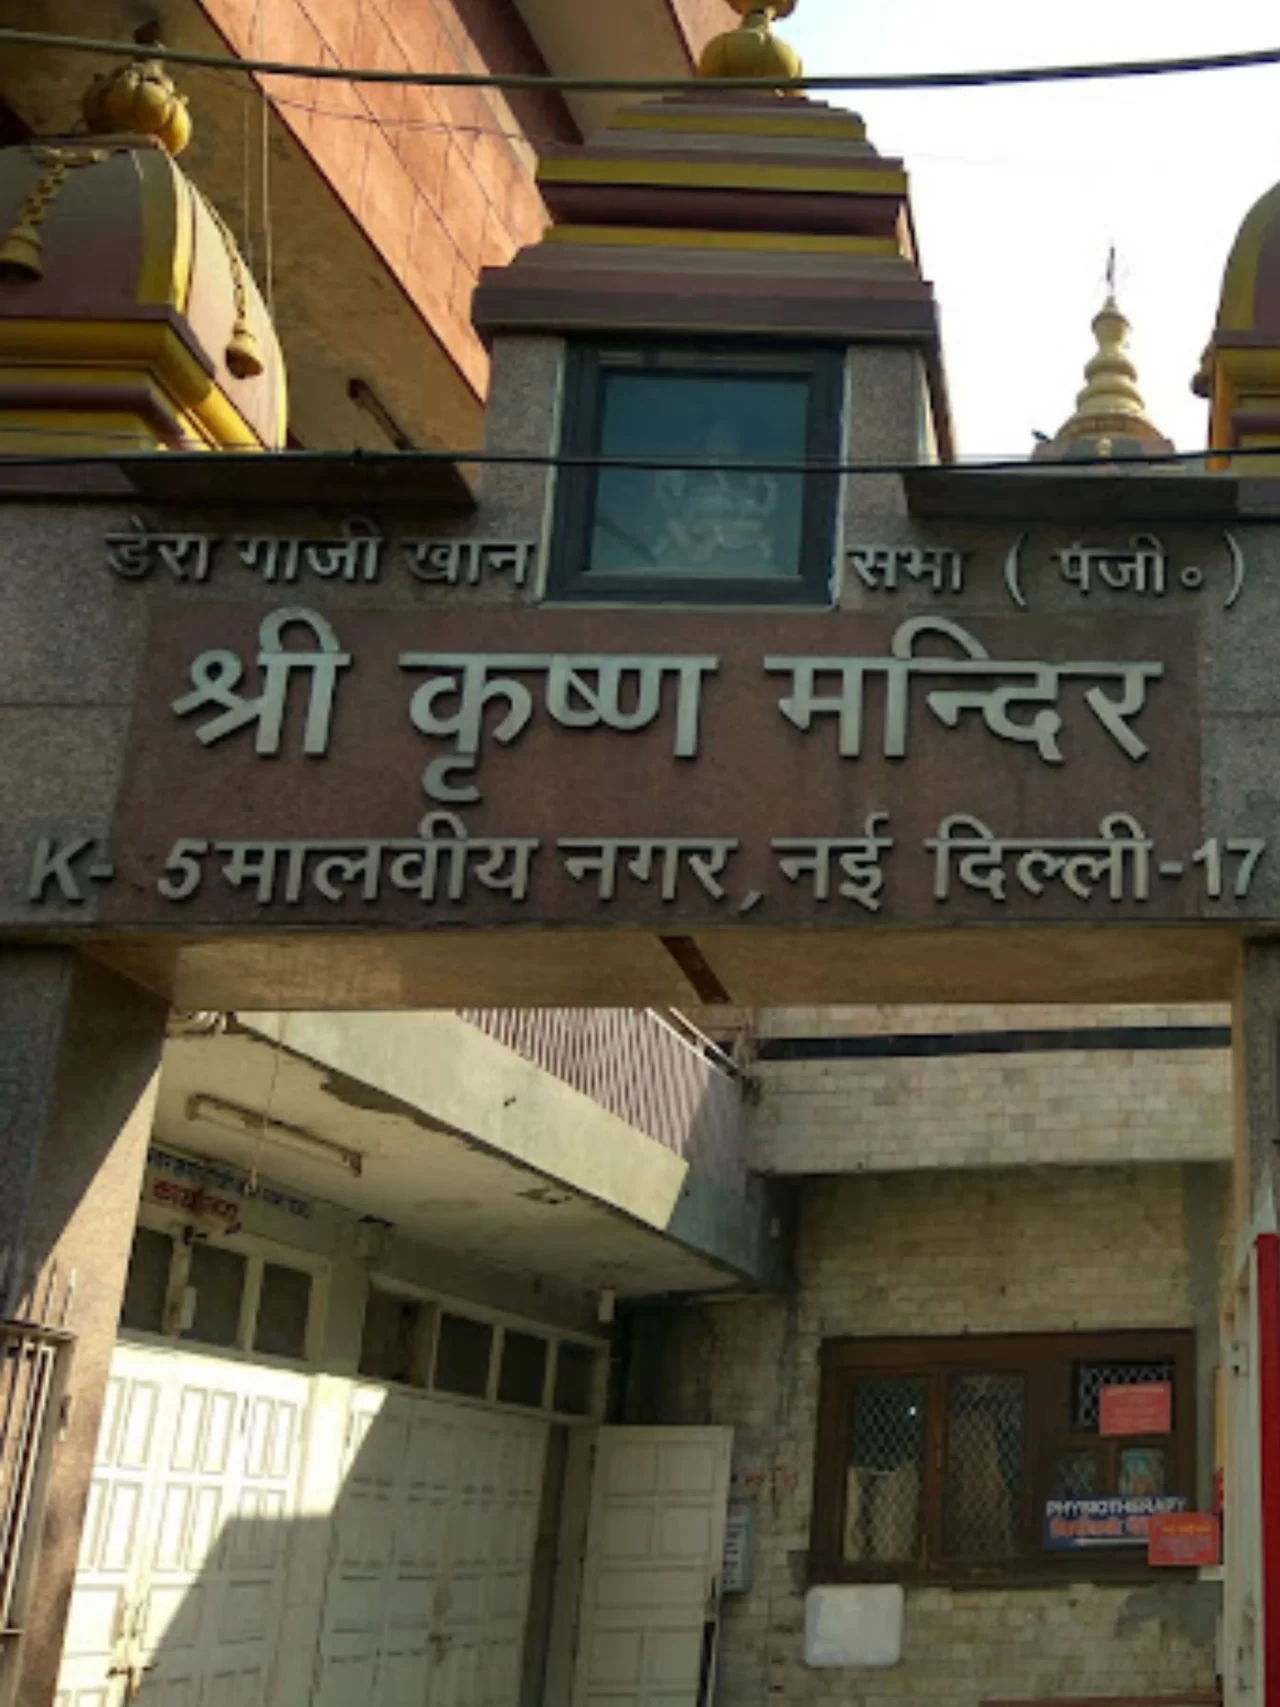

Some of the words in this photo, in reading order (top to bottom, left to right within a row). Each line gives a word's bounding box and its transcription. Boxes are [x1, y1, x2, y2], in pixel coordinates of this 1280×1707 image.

[104, 515, 214, 582] डेरा
[235, 516, 384, 583] गाजी
[403, 537, 538, 585] खान
[846, 544, 973, 594] सभा
[170, 607, 351, 757] श्री
[399, 652, 719, 803] कृष्ण
[764, 617, 1164, 764] मन्दिर
[770, 811, 893, 912] नई
